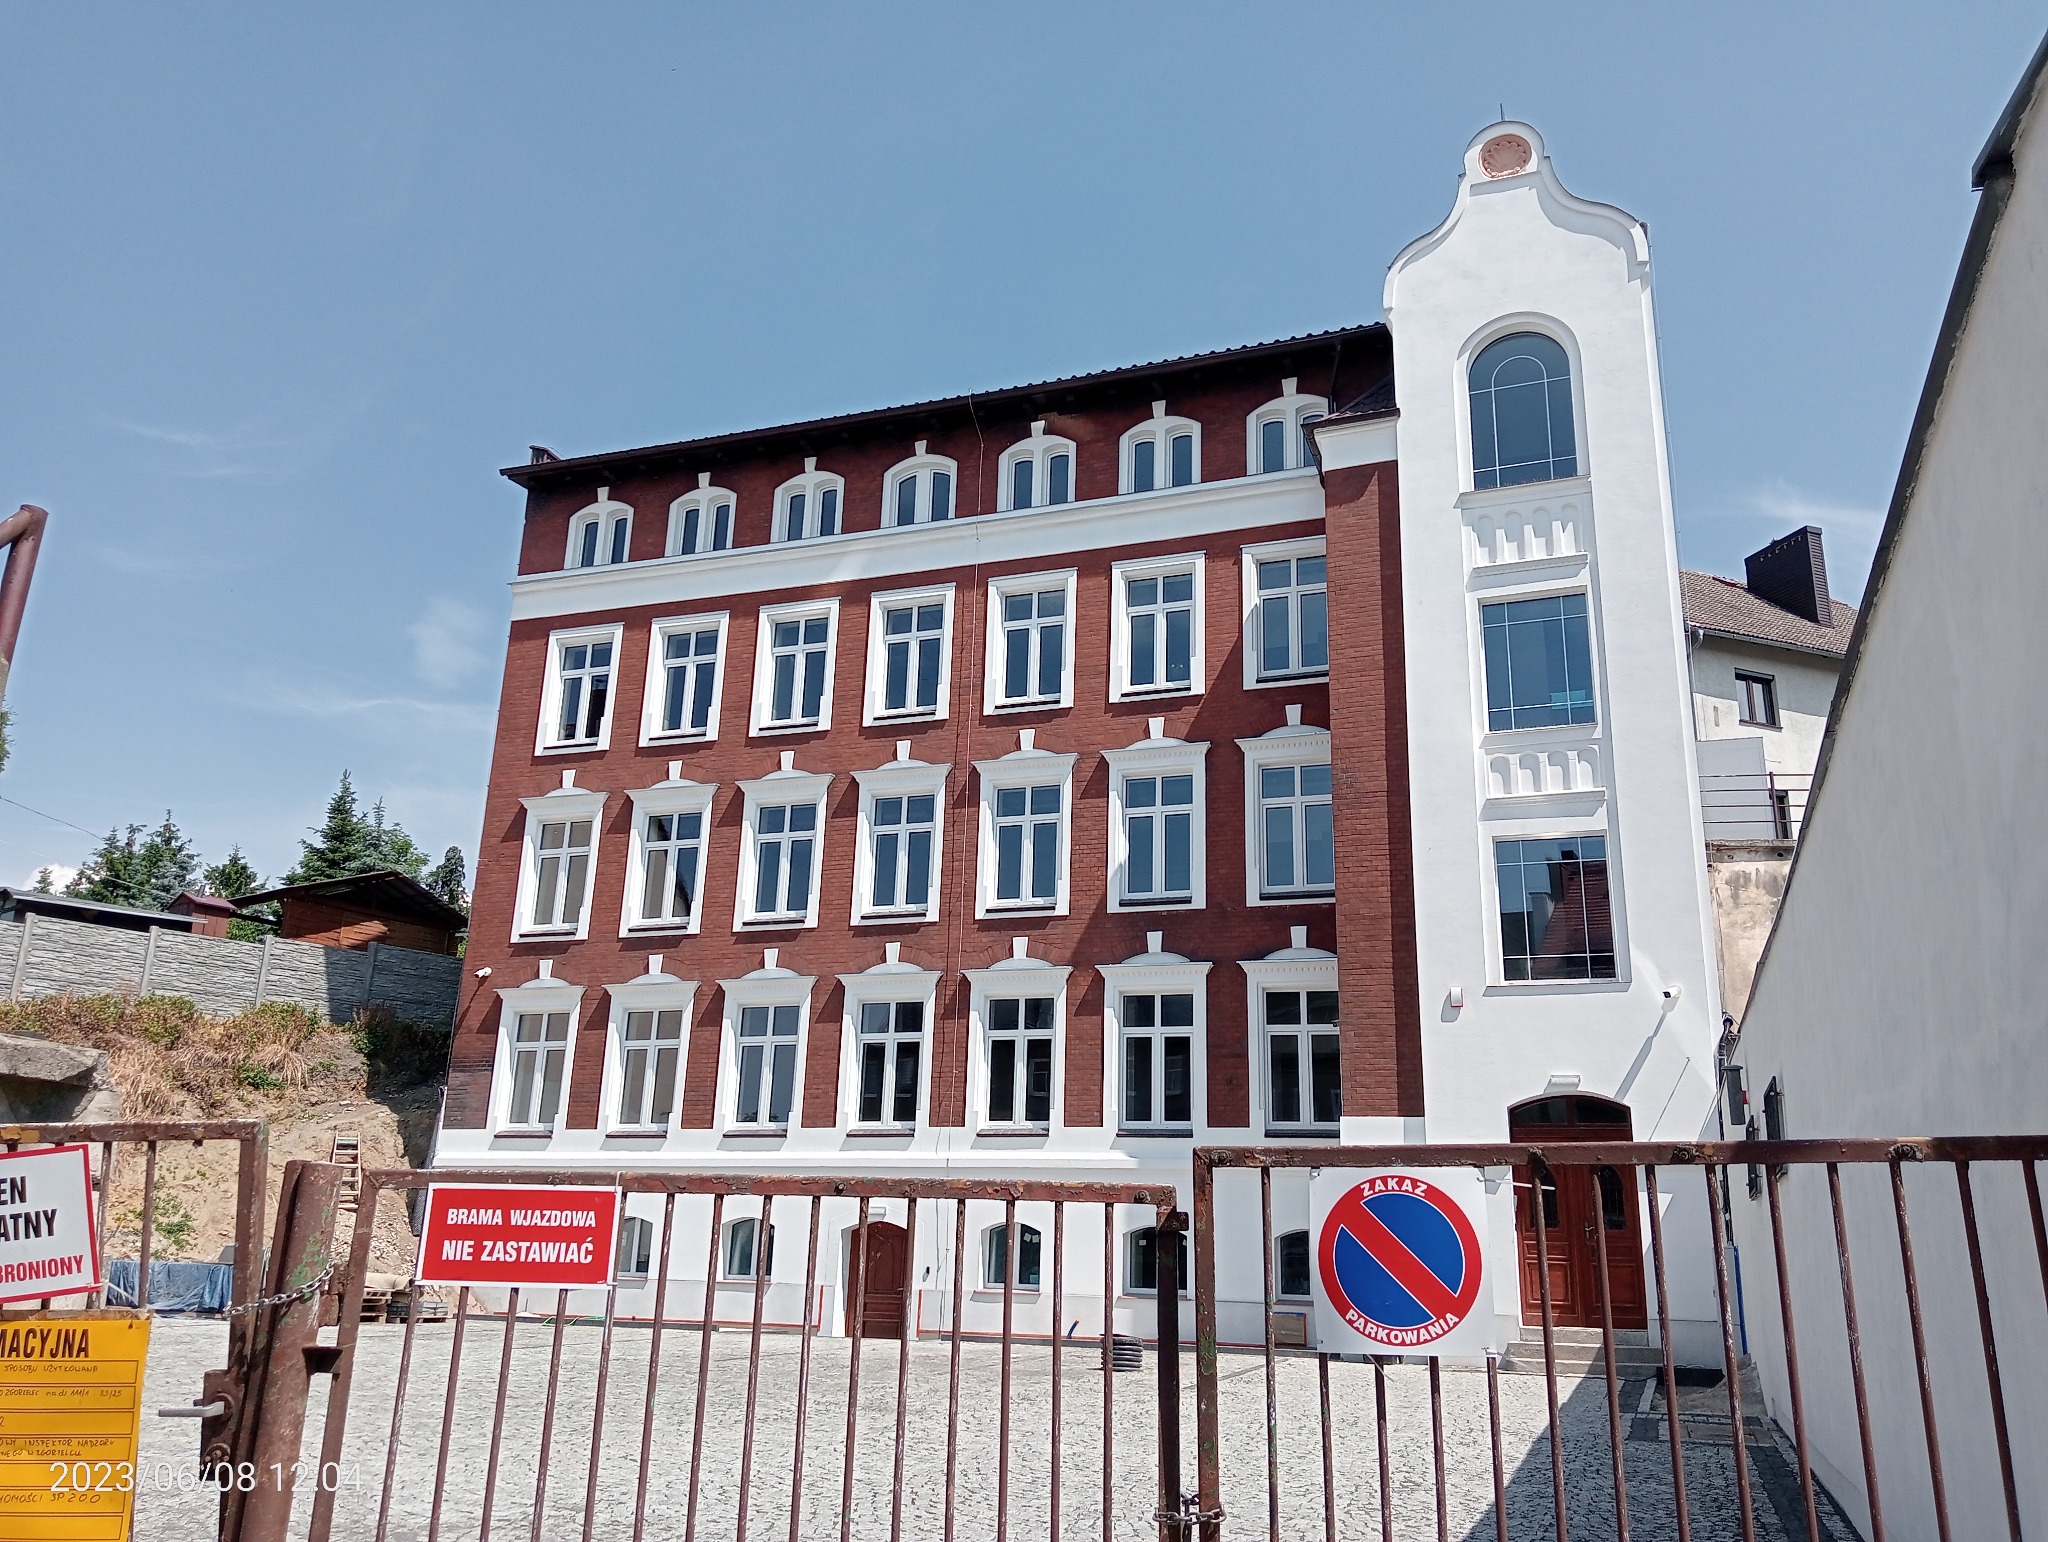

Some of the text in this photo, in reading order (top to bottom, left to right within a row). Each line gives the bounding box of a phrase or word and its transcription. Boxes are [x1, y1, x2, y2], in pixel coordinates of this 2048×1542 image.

[1360, 1177, 1428, 1197] ZAKAZ
[446, 1208, 596, 1228] BRAMA WJAZDOWA
[441, 1236, 594, 1264] NIE ZASTAWIAĆ
[1345, 1308, 1460, 1344] PARKOWANIA
